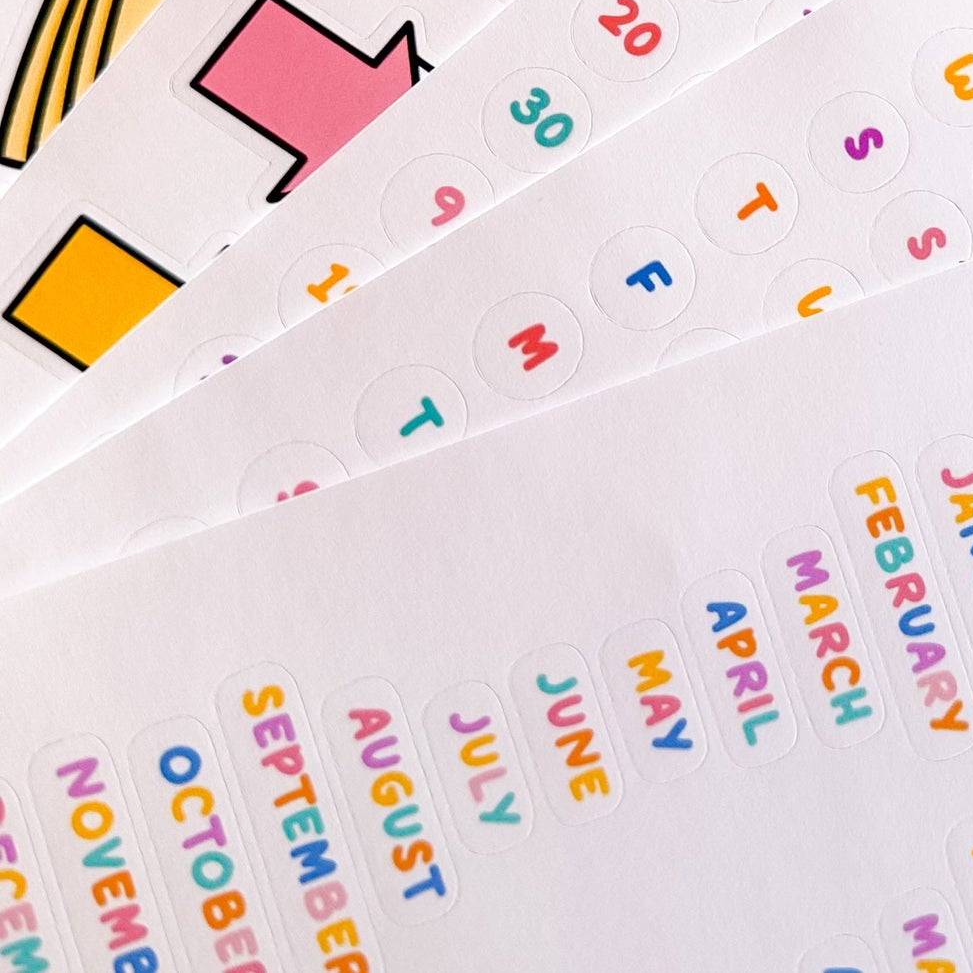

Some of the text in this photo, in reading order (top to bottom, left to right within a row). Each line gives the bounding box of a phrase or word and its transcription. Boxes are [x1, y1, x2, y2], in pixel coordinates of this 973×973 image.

[511, 88, 573, 147] 30
[844, 128, 884, 160] S
[432, 186, 465, 226] 9
[737, 181, 779, 221] T
[907, 228, 946, 260] S
[306, 263, 356, 304] 1
[626, 261, 672, 292] F
[507, 323, 559, 371] M
[400, 397, 444, 436] T
[854, 476, 969, 732] FEBRUARY
[787, 551, 871, 724] MARCH
[627, 650, 693, 750] MAY
[707, 602, 778, 745] APRIL
[537, 676, 610, 802] JUNE
[450, 714, 520, 823] JULY
[348, 709, 446, 899] AUGUST
